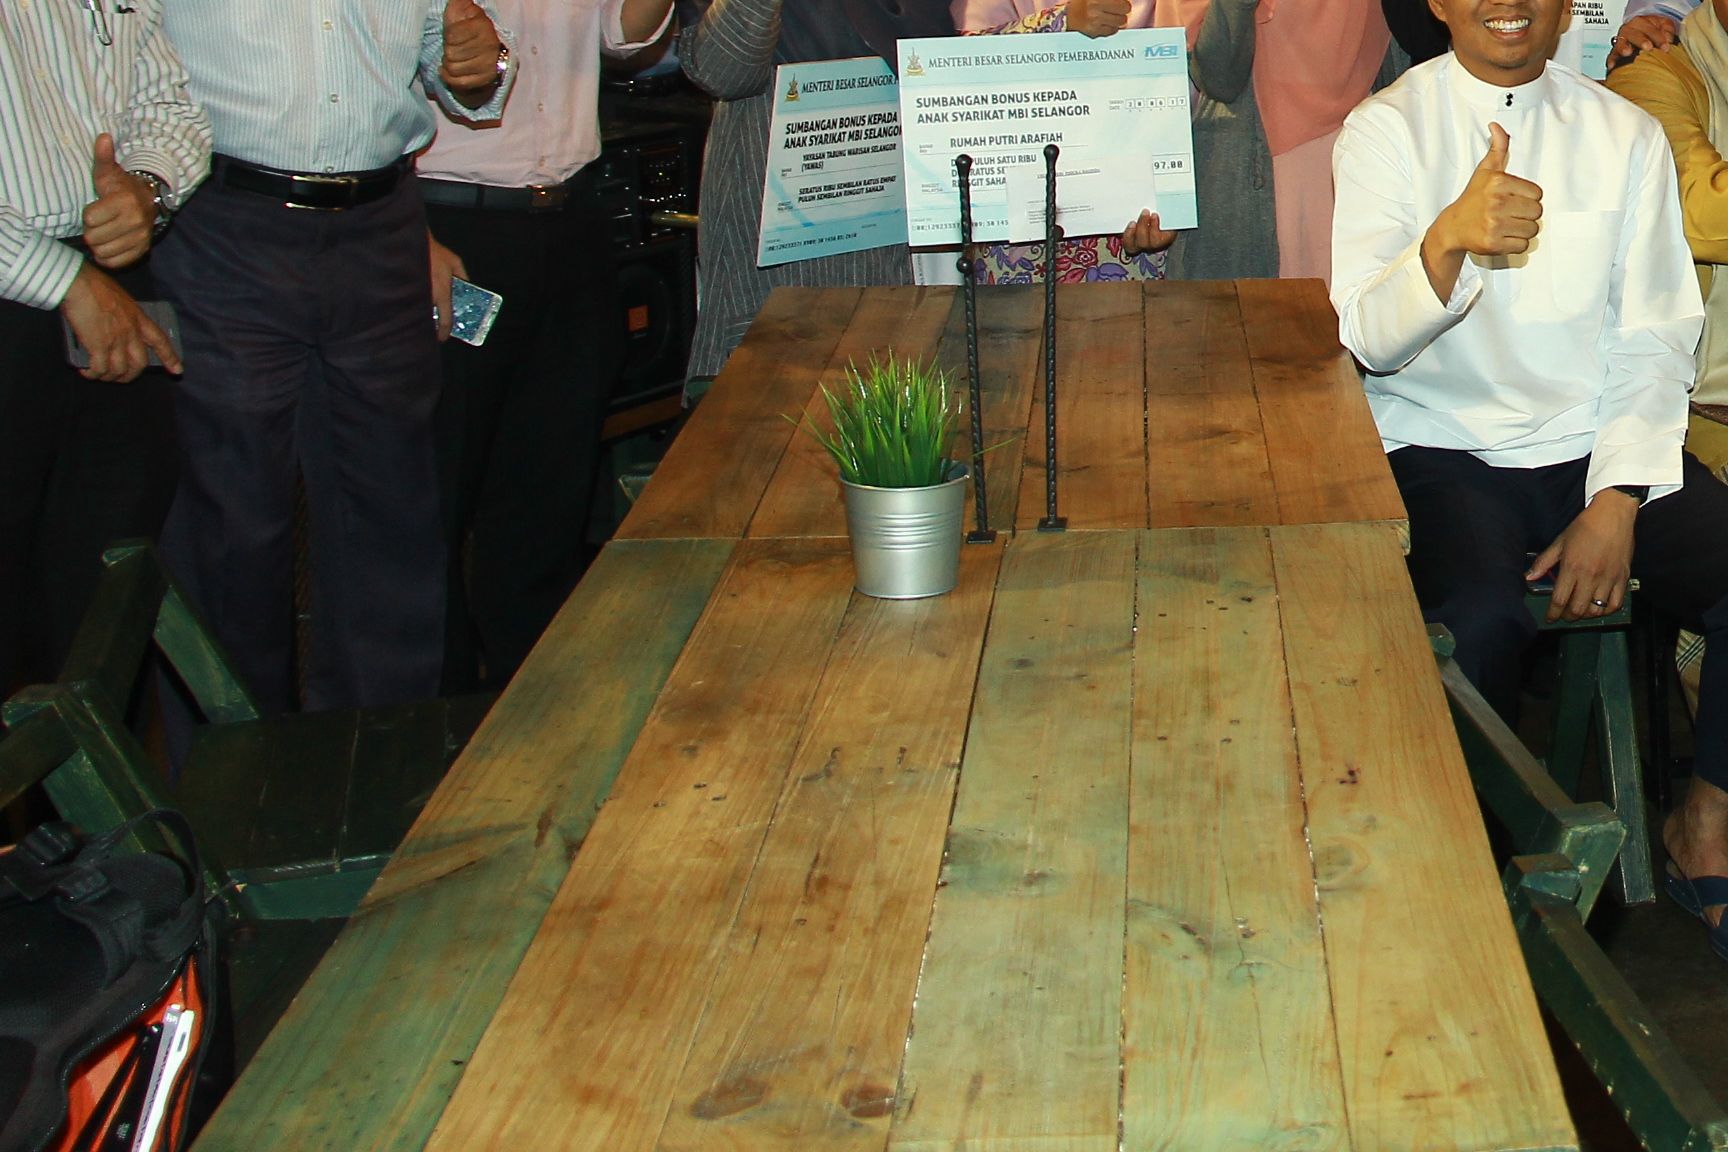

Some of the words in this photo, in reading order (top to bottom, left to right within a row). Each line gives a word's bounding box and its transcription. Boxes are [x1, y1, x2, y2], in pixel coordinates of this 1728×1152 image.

[928, 56, 971, 67] MENTERI
[974, 54, 1003, 65] BESAR
[1005, 52, 1056, 64] SELANGOR
[1058, 48, 1134, 62] PEMERBADANAN
[801, 80, 834, 93] MENTERI
[835, 78, 856, 90] BESAR
[857, 75, 894, 88] SELANGOR
[916, 94, 988, 108] SUMBANGAN
[991, 92, 1030, 104] BONUS
[1033, 90, 1077, 102] KEPADA
[785, 118, 837, 134] SUMBANGAN
[838, 114, 866, 129] BONUS
[867, 111, 897, 125] KEPADA
[917, 112, 948, 123] ANAK
[951, 109, 1004, 122] SYARIKAT
[1007, 108, 1028, 119] MBI
[1031, 104, 1089, 118] SELANGOR
[783, 135, 807, 149] ANAK
[808, 131, 847, 146] SYARIKAT
[847, 129, 863, 141] MBI
[950, 136, 986, 147] RUMAH
[988, 134, 1018, 145] PUTRI
[1020, 132, 1062, 145] ARAFIAH
[972, 156, 995, 165] ULUH
[996, 155, 1016, 164] SATU
[1017, 154, 1036, 163] RIBU
